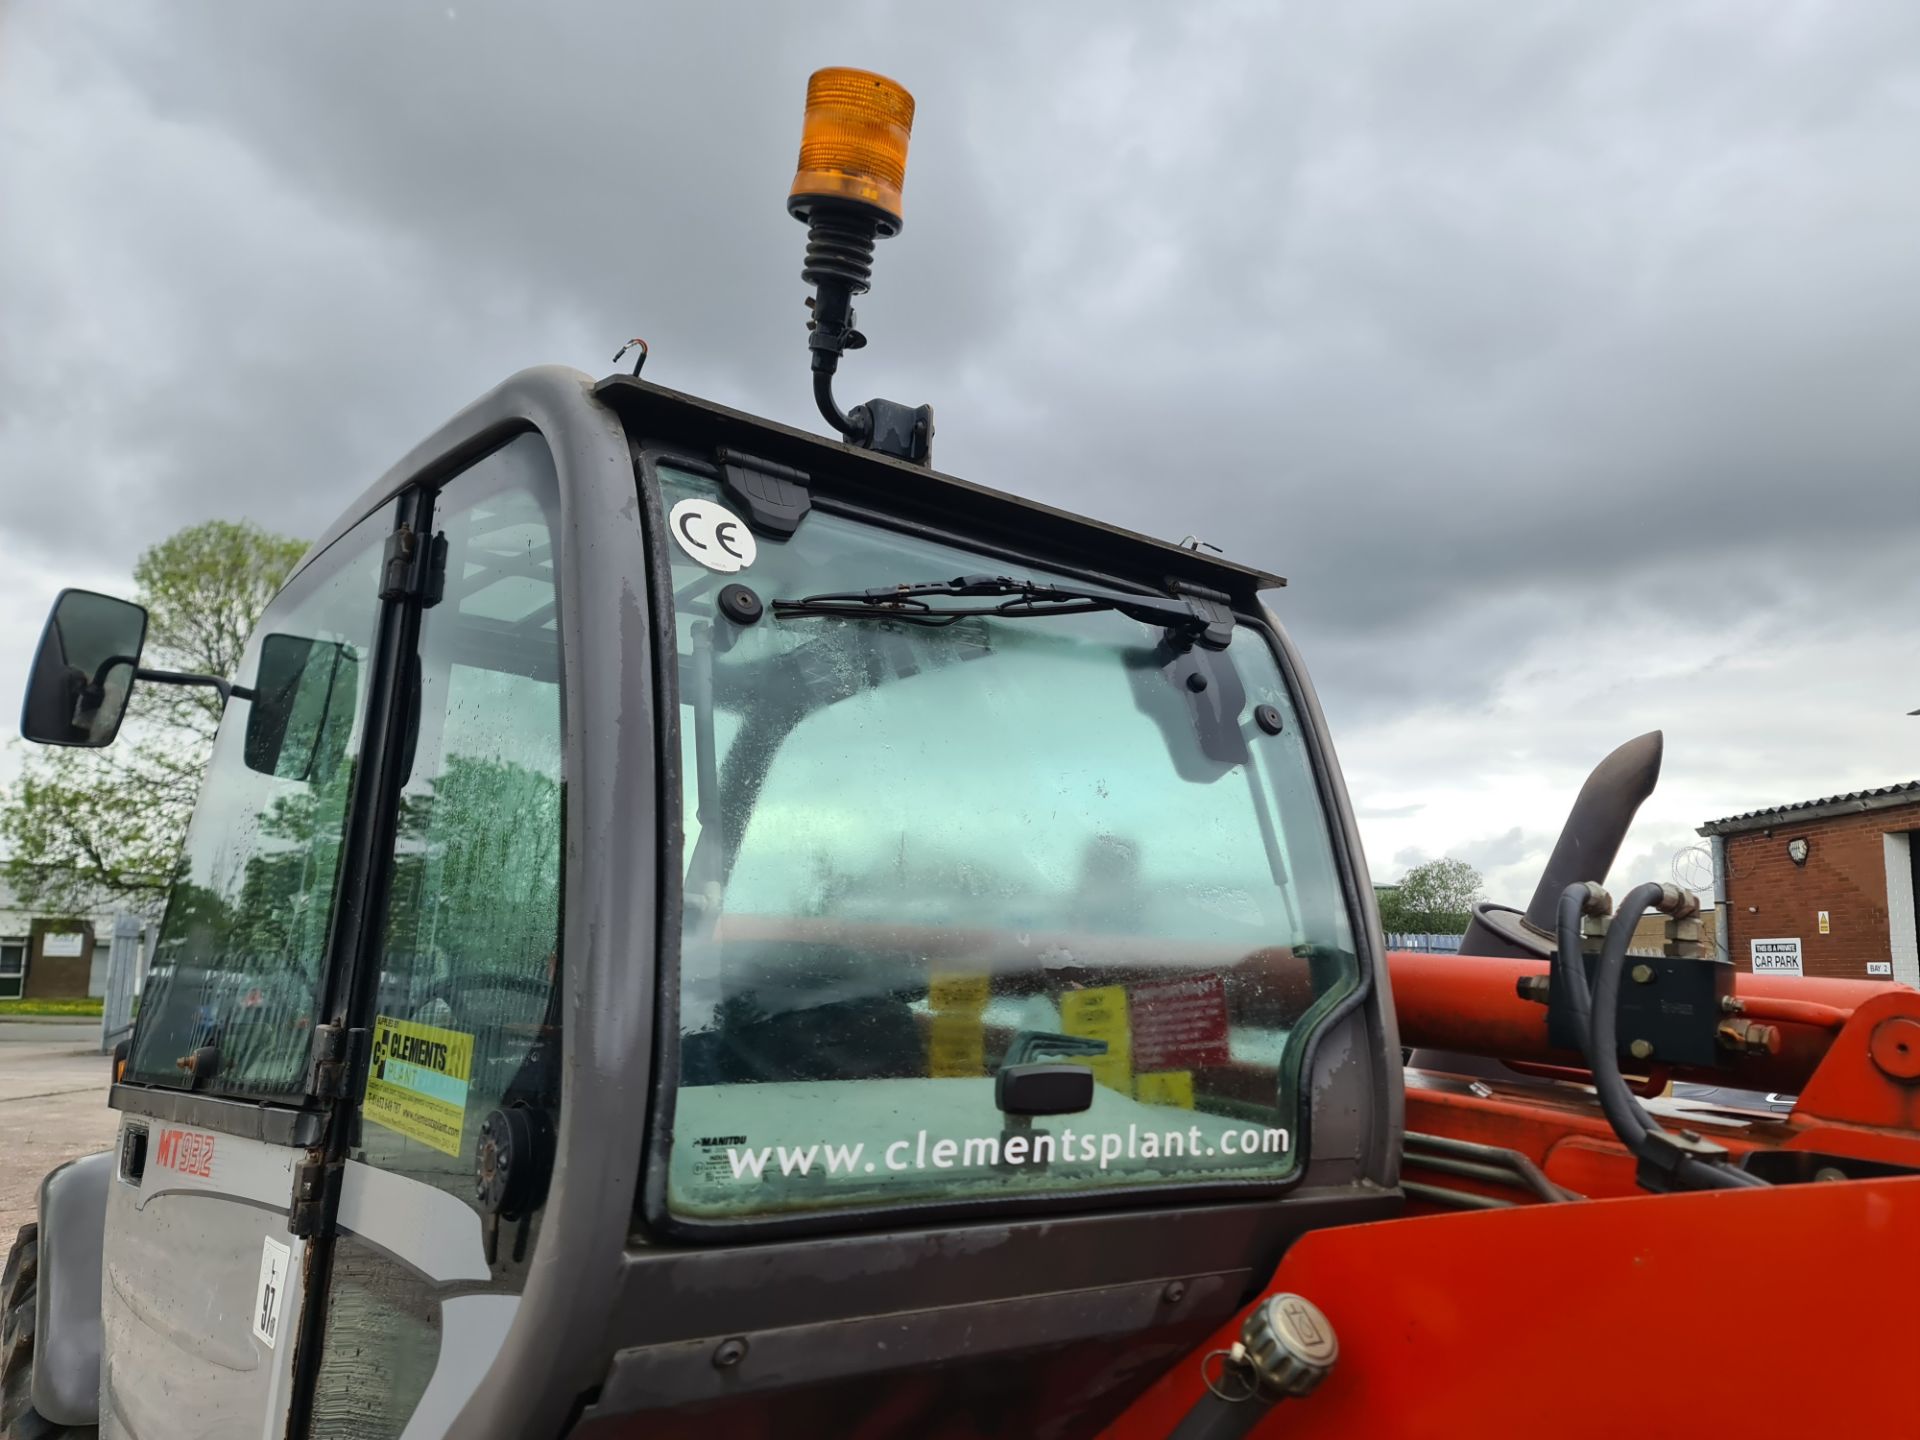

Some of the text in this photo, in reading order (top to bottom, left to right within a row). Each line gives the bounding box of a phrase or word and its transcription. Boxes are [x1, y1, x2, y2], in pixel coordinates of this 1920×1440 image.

[680, 513, 742, 559] CE
[1755, 956, 1798, 967] CAR PARK
[390, 1033, 447, 1071] CLEMENTS
[388, 1063, 418, 1086] PLANT
[701, 1136, 747, 1147] MANITOU
[727, 1124, 1289, 1179] www.clementsplant.com
[261, 1284, 275, 1334] 97
